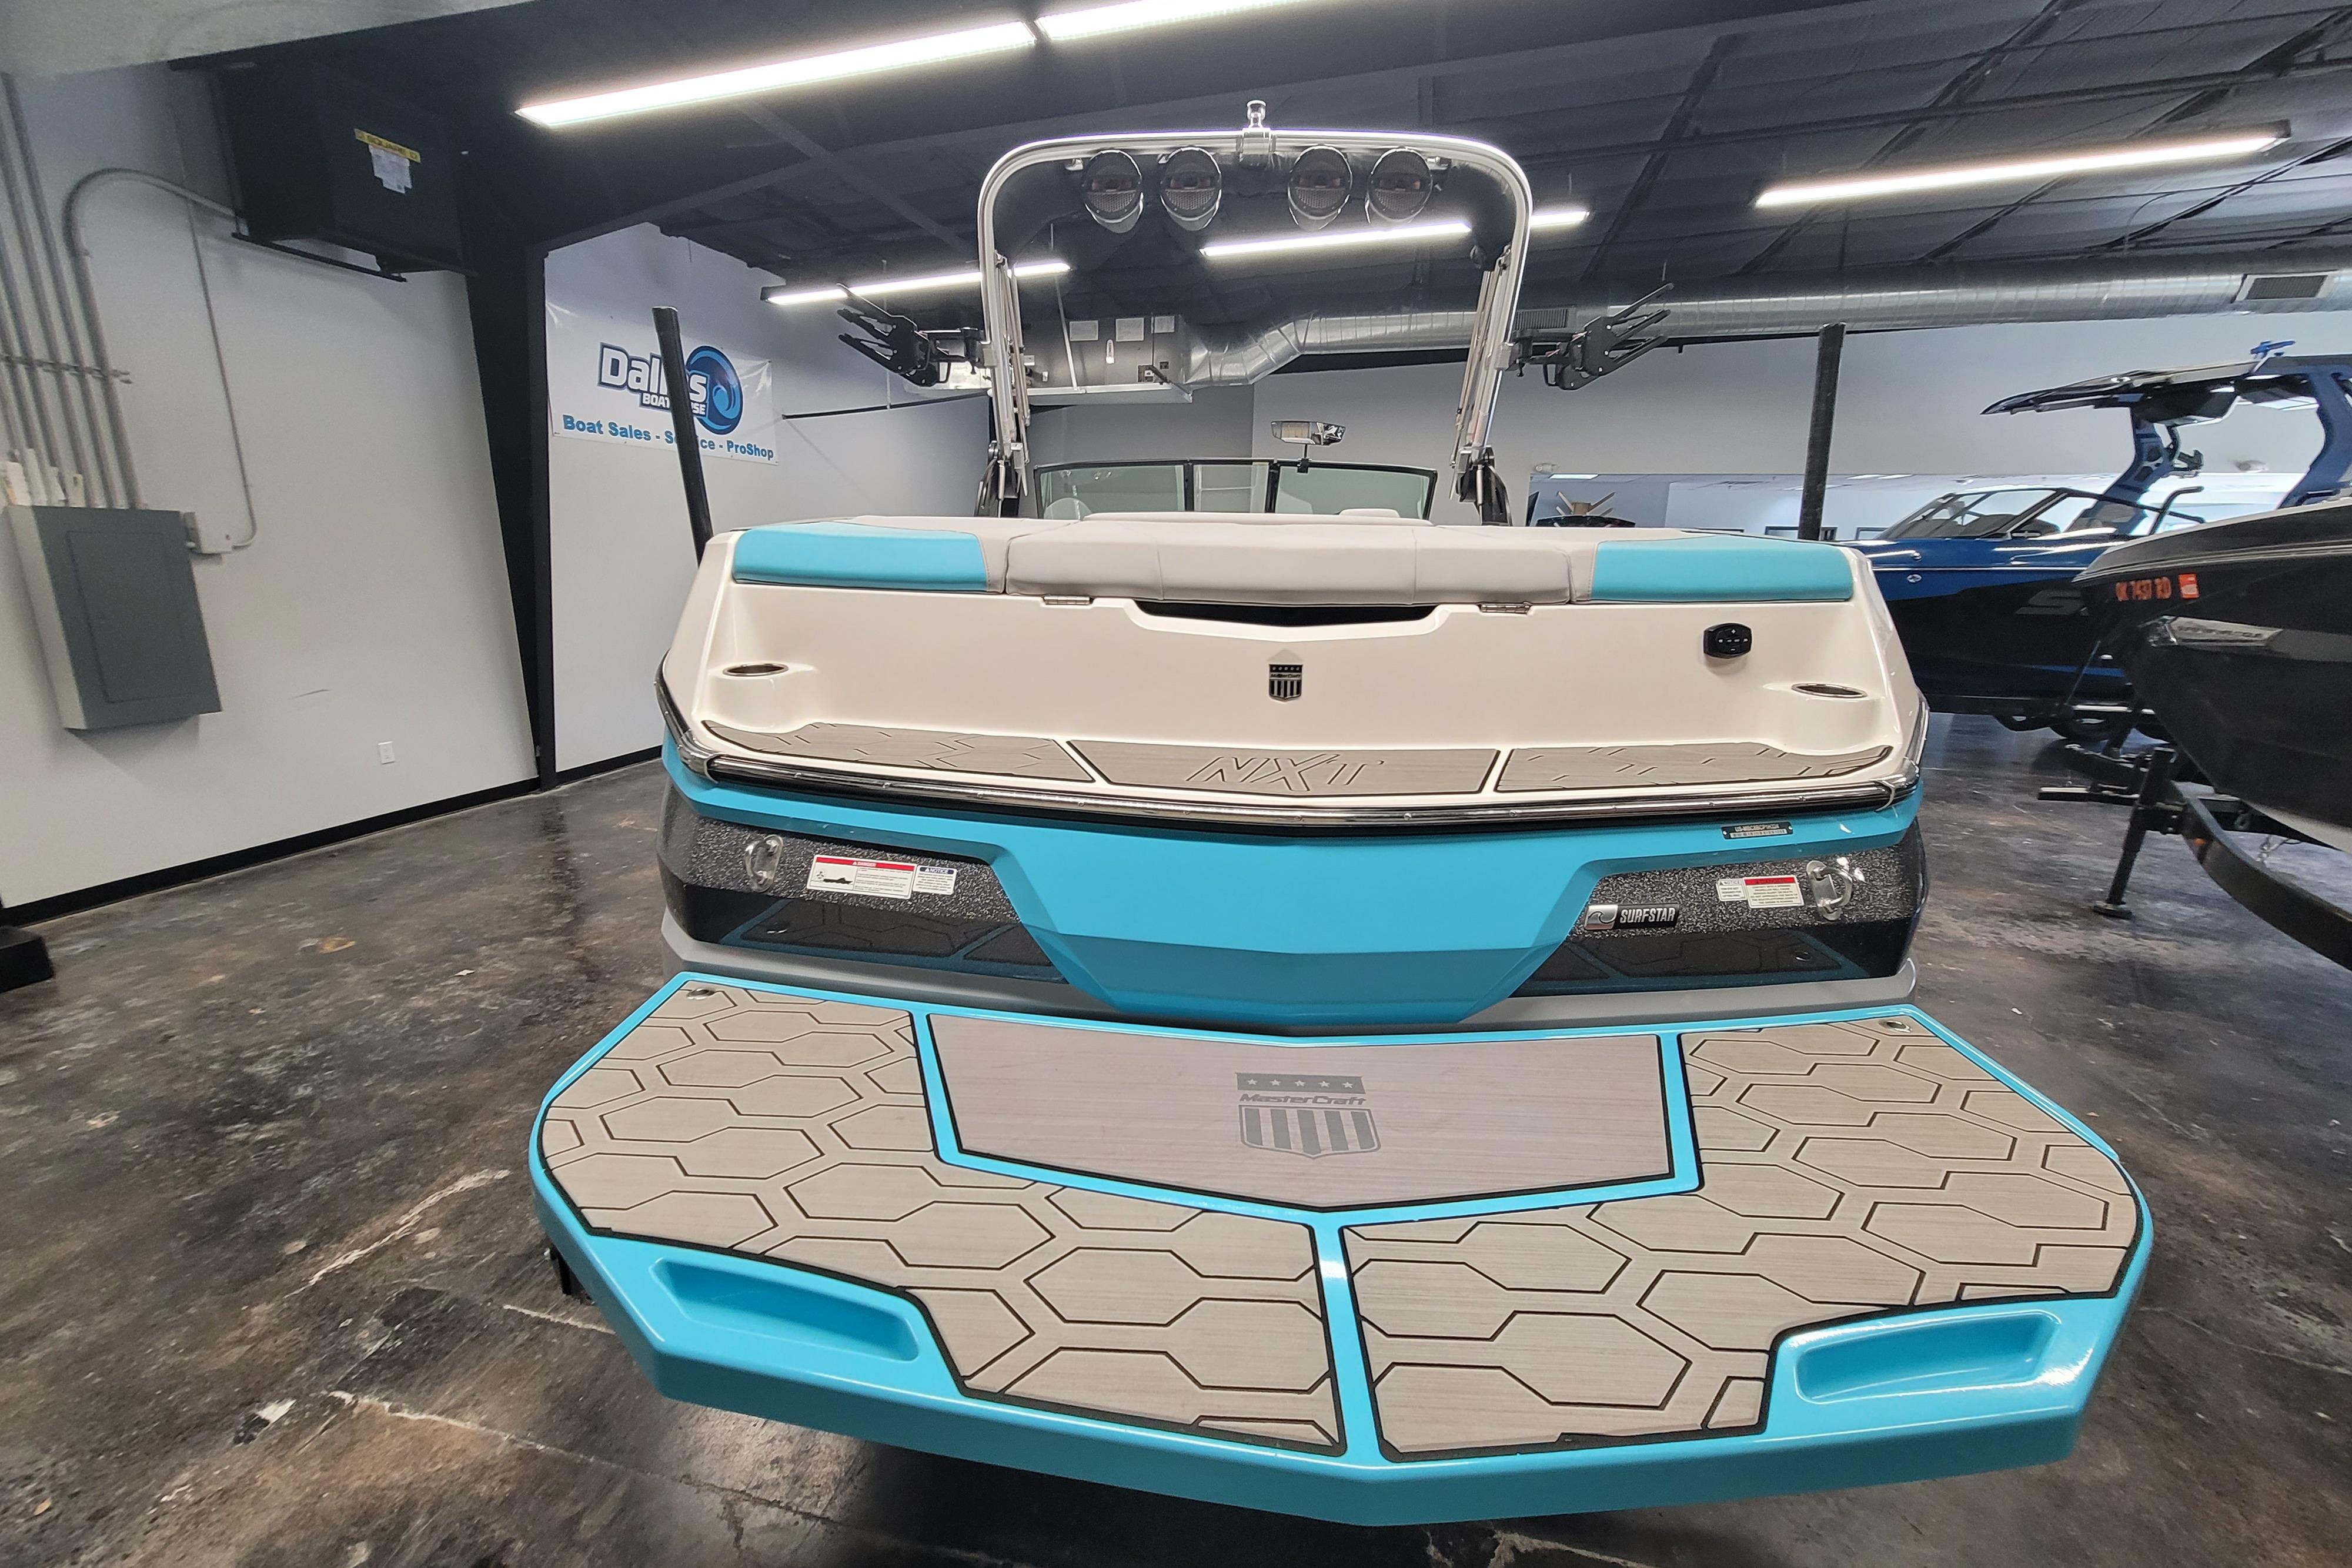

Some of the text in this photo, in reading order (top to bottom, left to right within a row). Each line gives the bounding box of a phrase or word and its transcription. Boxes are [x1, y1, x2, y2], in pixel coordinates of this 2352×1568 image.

[599, 343, 708, 403] Dalls
[563, 414, 604, 435] Boat
[608, 422, 652, 441] Sales
[727, 440, 774, 461] ProShop
[1185, 753, 1385, 791] NXT
[1619, 907, 1676, 924] SURFSTAR
[1240, 1094, 1367, 1105] MasterCraft
